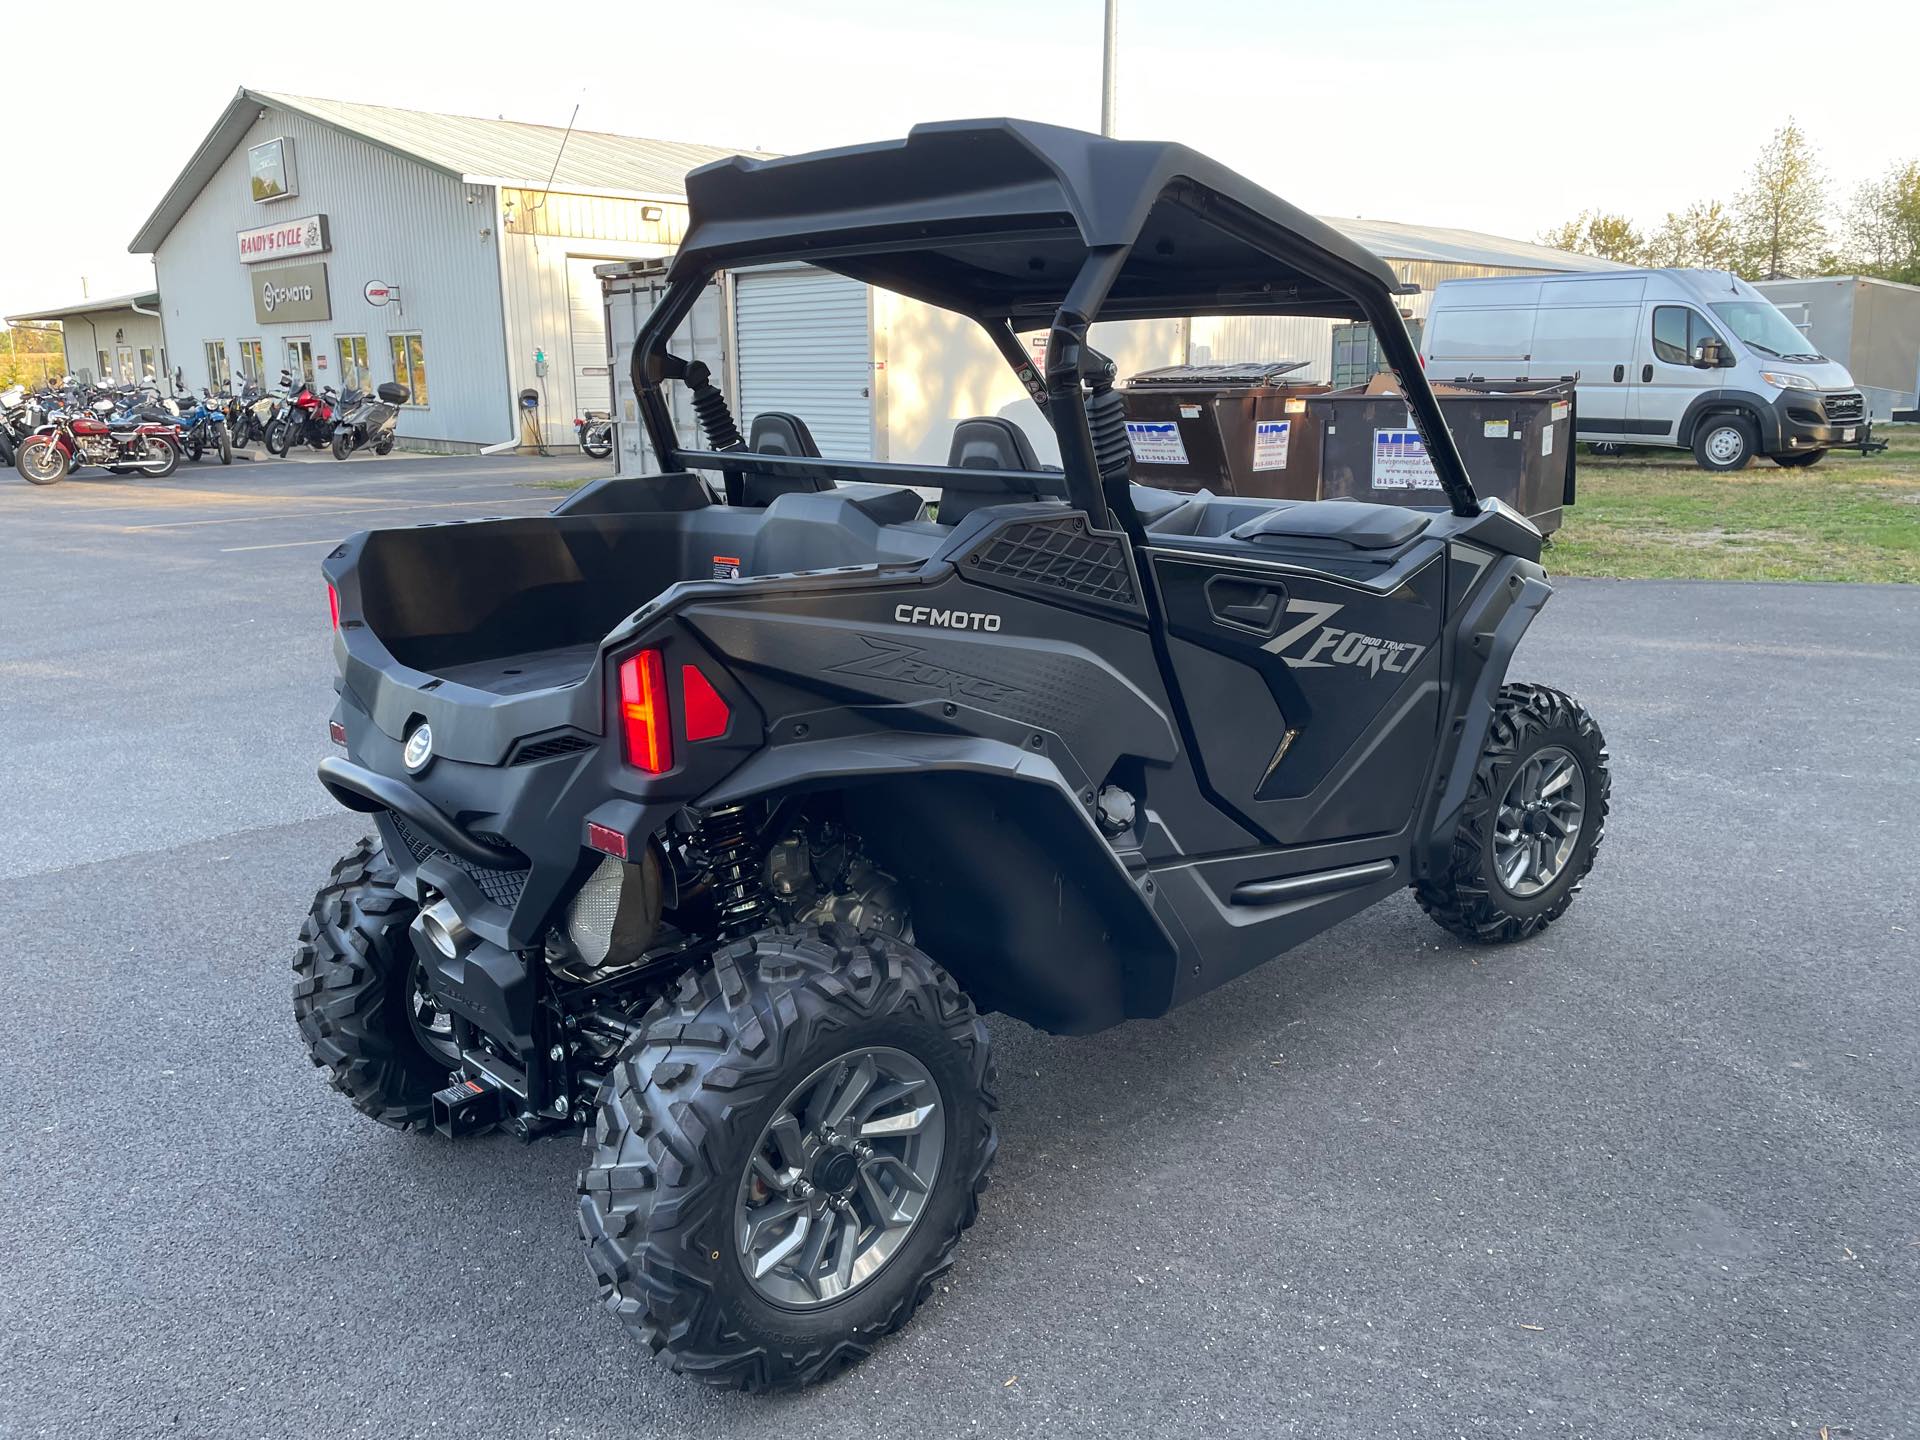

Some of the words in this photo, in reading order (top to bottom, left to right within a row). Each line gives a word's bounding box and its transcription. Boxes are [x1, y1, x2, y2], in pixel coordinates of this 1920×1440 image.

[241, 233, 274, 254] RANDY'S
[276, 227, 302, 248] CYCLE
[274, 285, 312, 303] CFMOTO
[1127, 424, 1179, 441] MDC
[1257, 424, 1288, 444] MDC
[1377, 434, 1427, 457] MD
[1376, 478, 1440, 486] 815-568-727
[895, 604, 1001, 632] CFMOTO
[1362, 636, 1382, 646] 800
[1383, 639, 1406, 651] TRAIL
